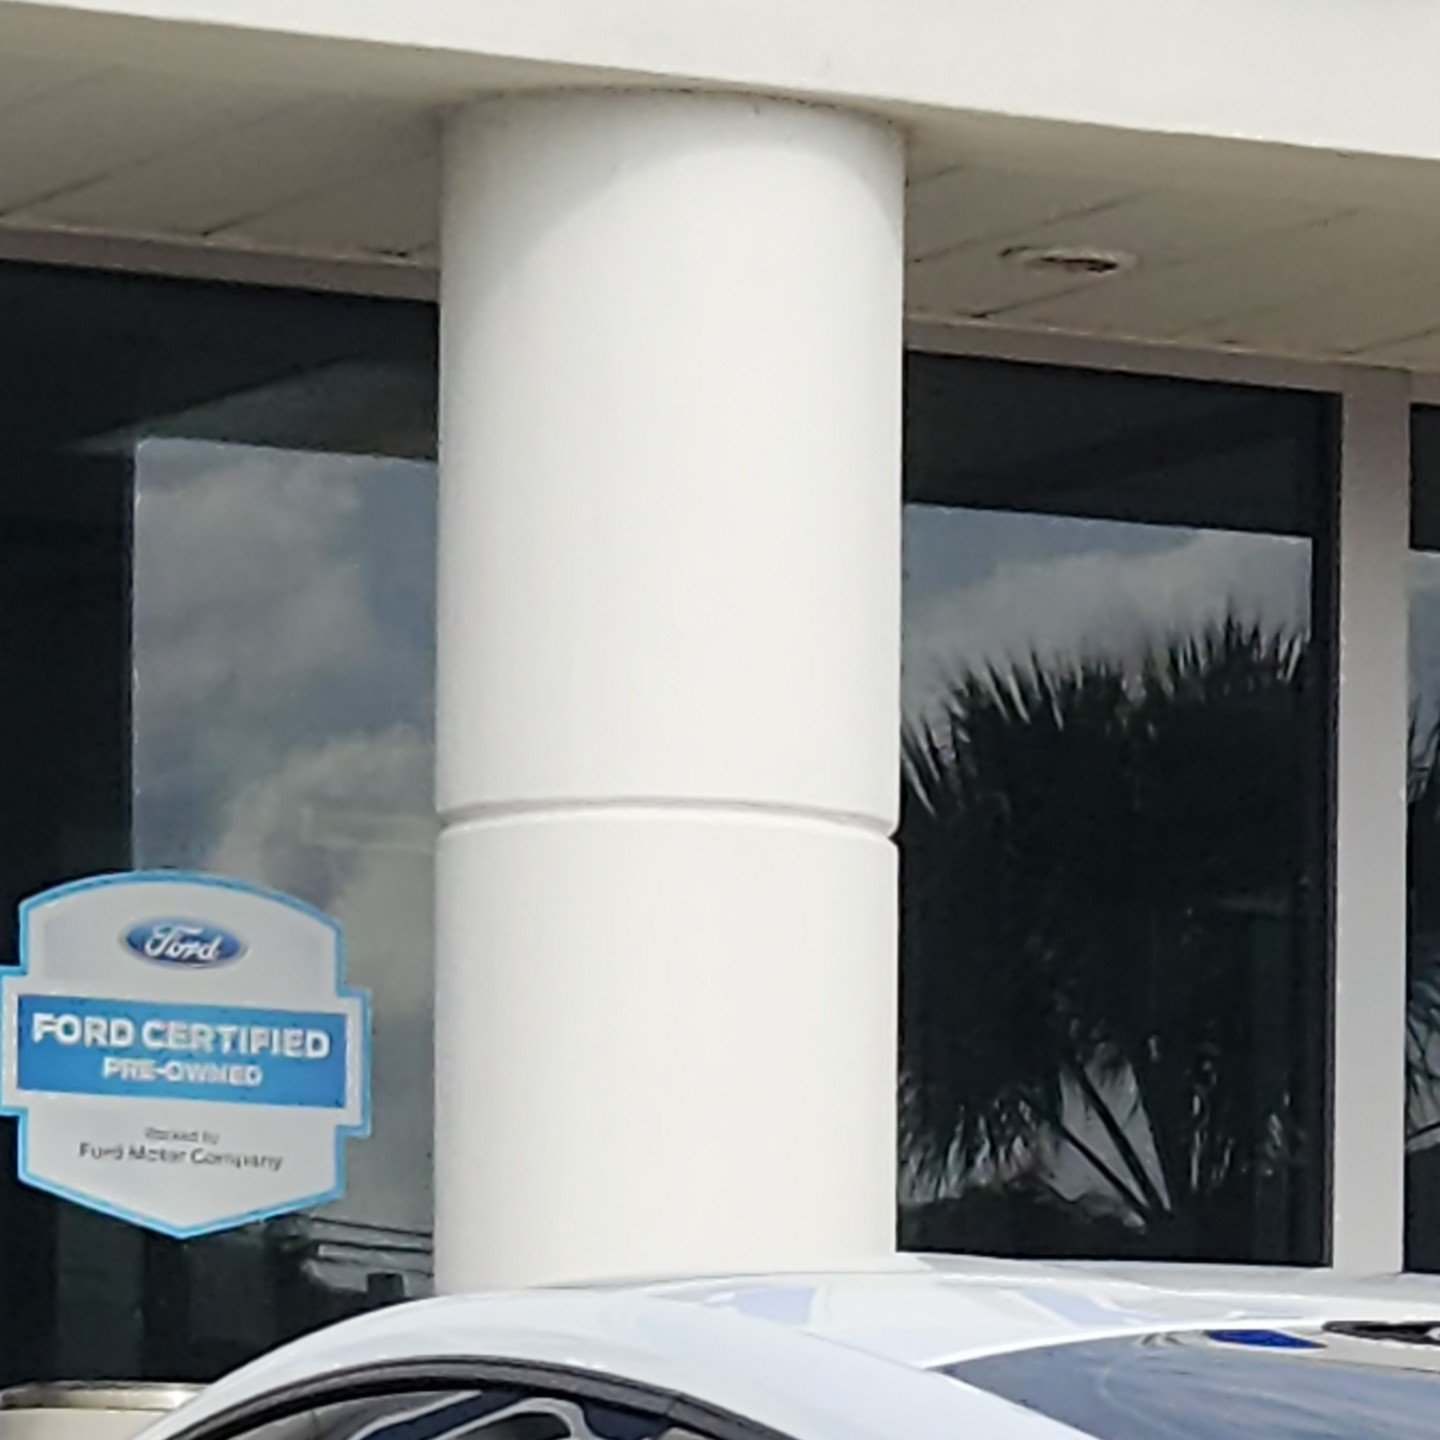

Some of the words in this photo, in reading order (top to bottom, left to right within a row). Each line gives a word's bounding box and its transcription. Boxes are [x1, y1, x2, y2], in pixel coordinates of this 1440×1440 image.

[144, 922, 220, 960] Ford
[32, 1012, 134, 1047] FORD
[142, 1020, 330, 1057] CERTIFIED
[102, 1056, 263, 1086] PRE-OWNED
